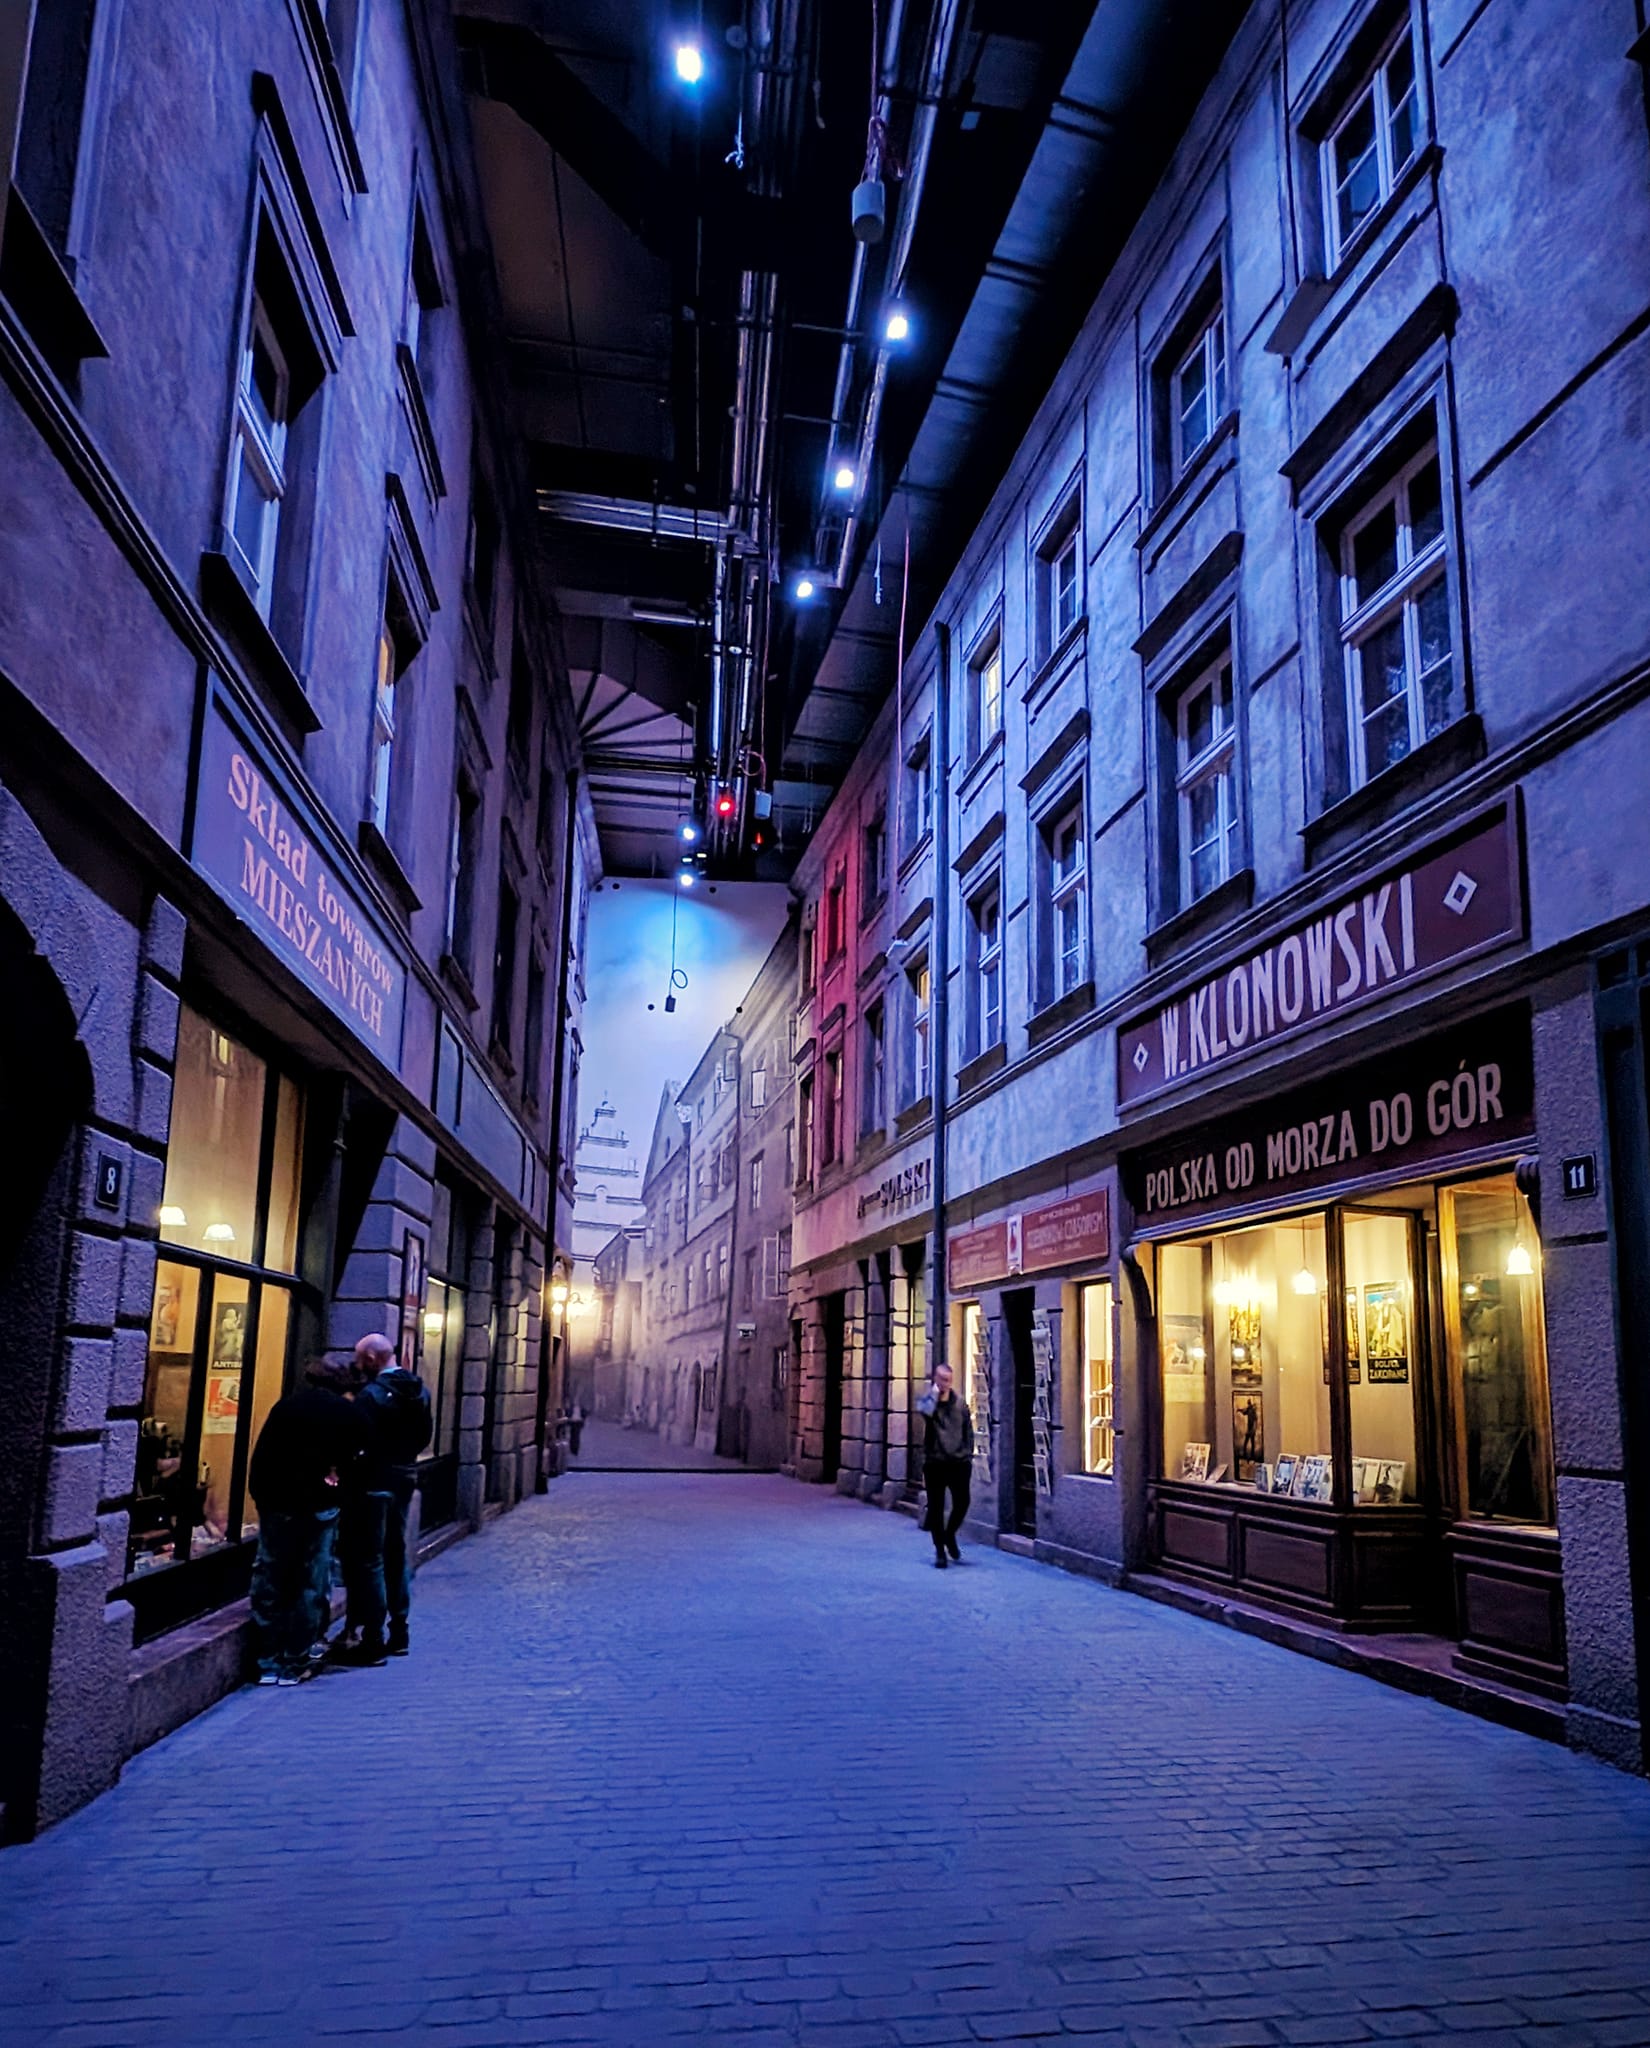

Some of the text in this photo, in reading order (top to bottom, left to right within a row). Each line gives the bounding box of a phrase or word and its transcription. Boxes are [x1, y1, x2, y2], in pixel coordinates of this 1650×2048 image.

[240, 836, 382, 1037] MIESZANYCH
[317, 873, 394, 995] towarów
[106, 1166, 116, 1194] 8
[1146, 1059, 1503, 1212] POLSKA OD MORZA DO GÓR
[1569, 1164, 1586, 1189] 11
